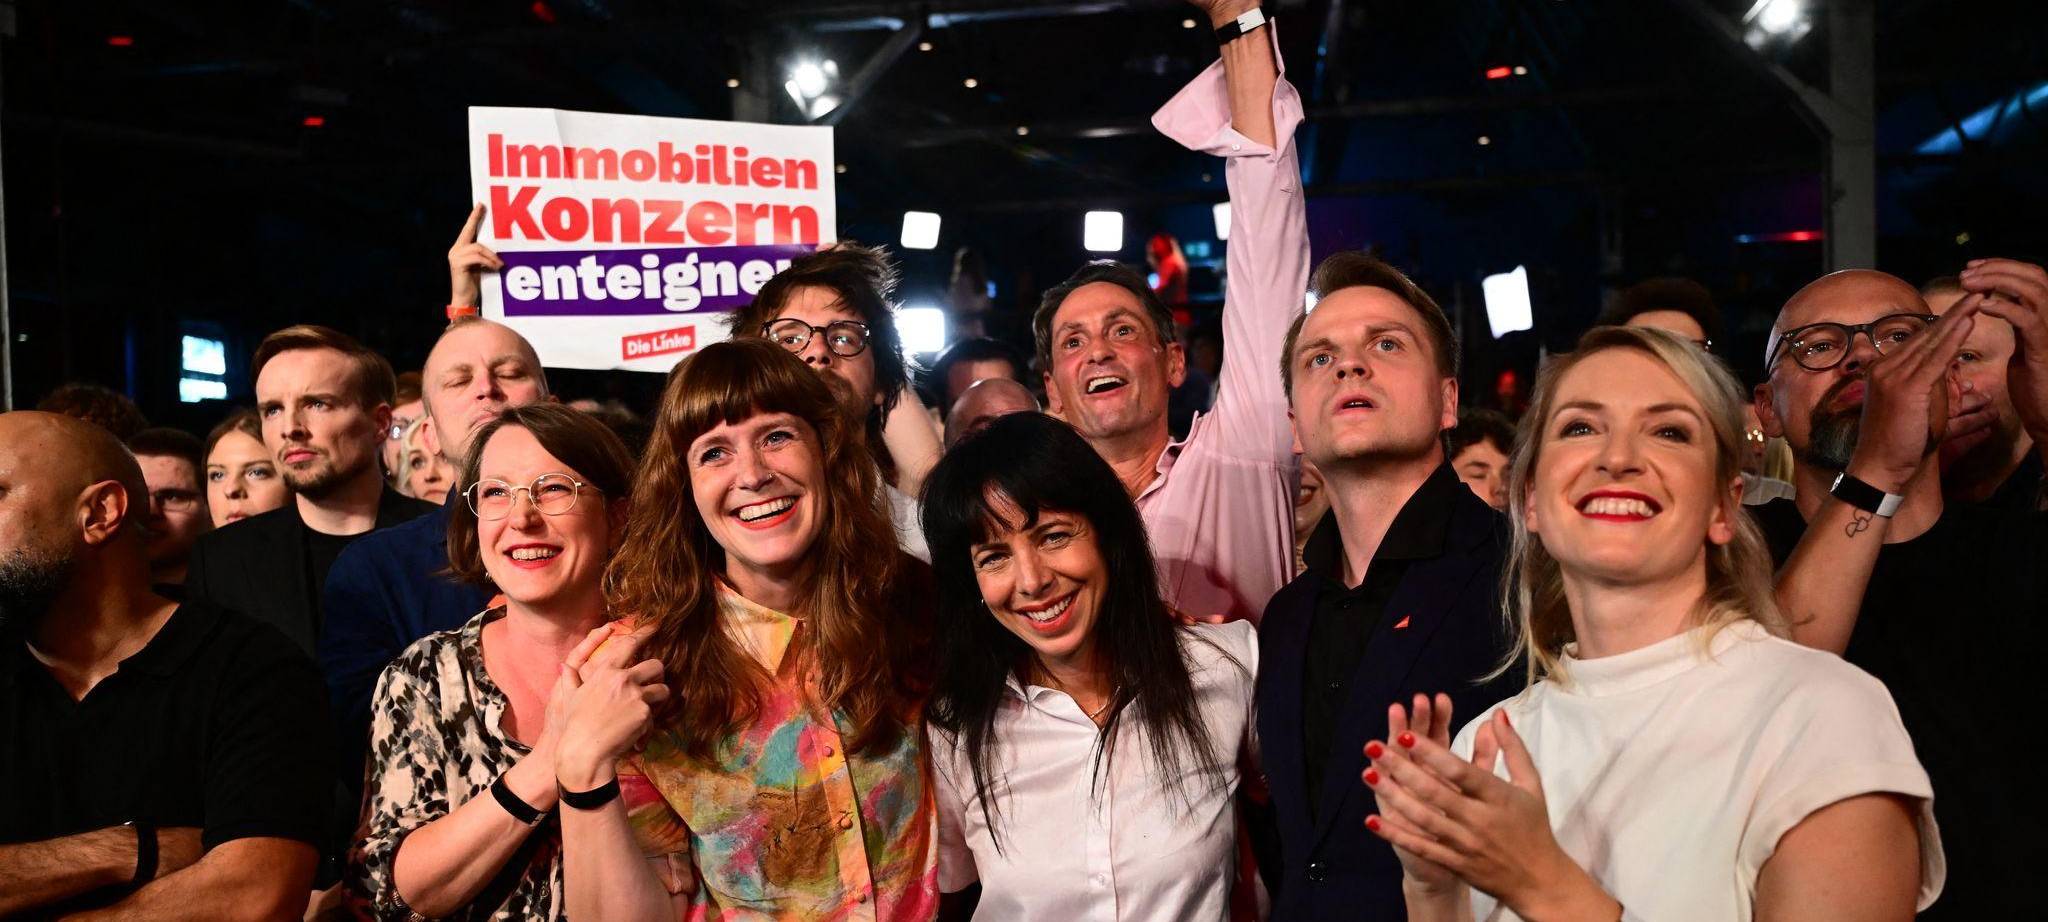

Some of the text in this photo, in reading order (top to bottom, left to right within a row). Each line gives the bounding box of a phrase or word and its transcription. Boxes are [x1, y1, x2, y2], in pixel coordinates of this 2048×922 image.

[488, 134, 818, 189] Immobilien
[490, 185, 819, 246] Konzern
[505, 252, 792, 312] enteigne
[627, 332, 692, 356] Die Linke
